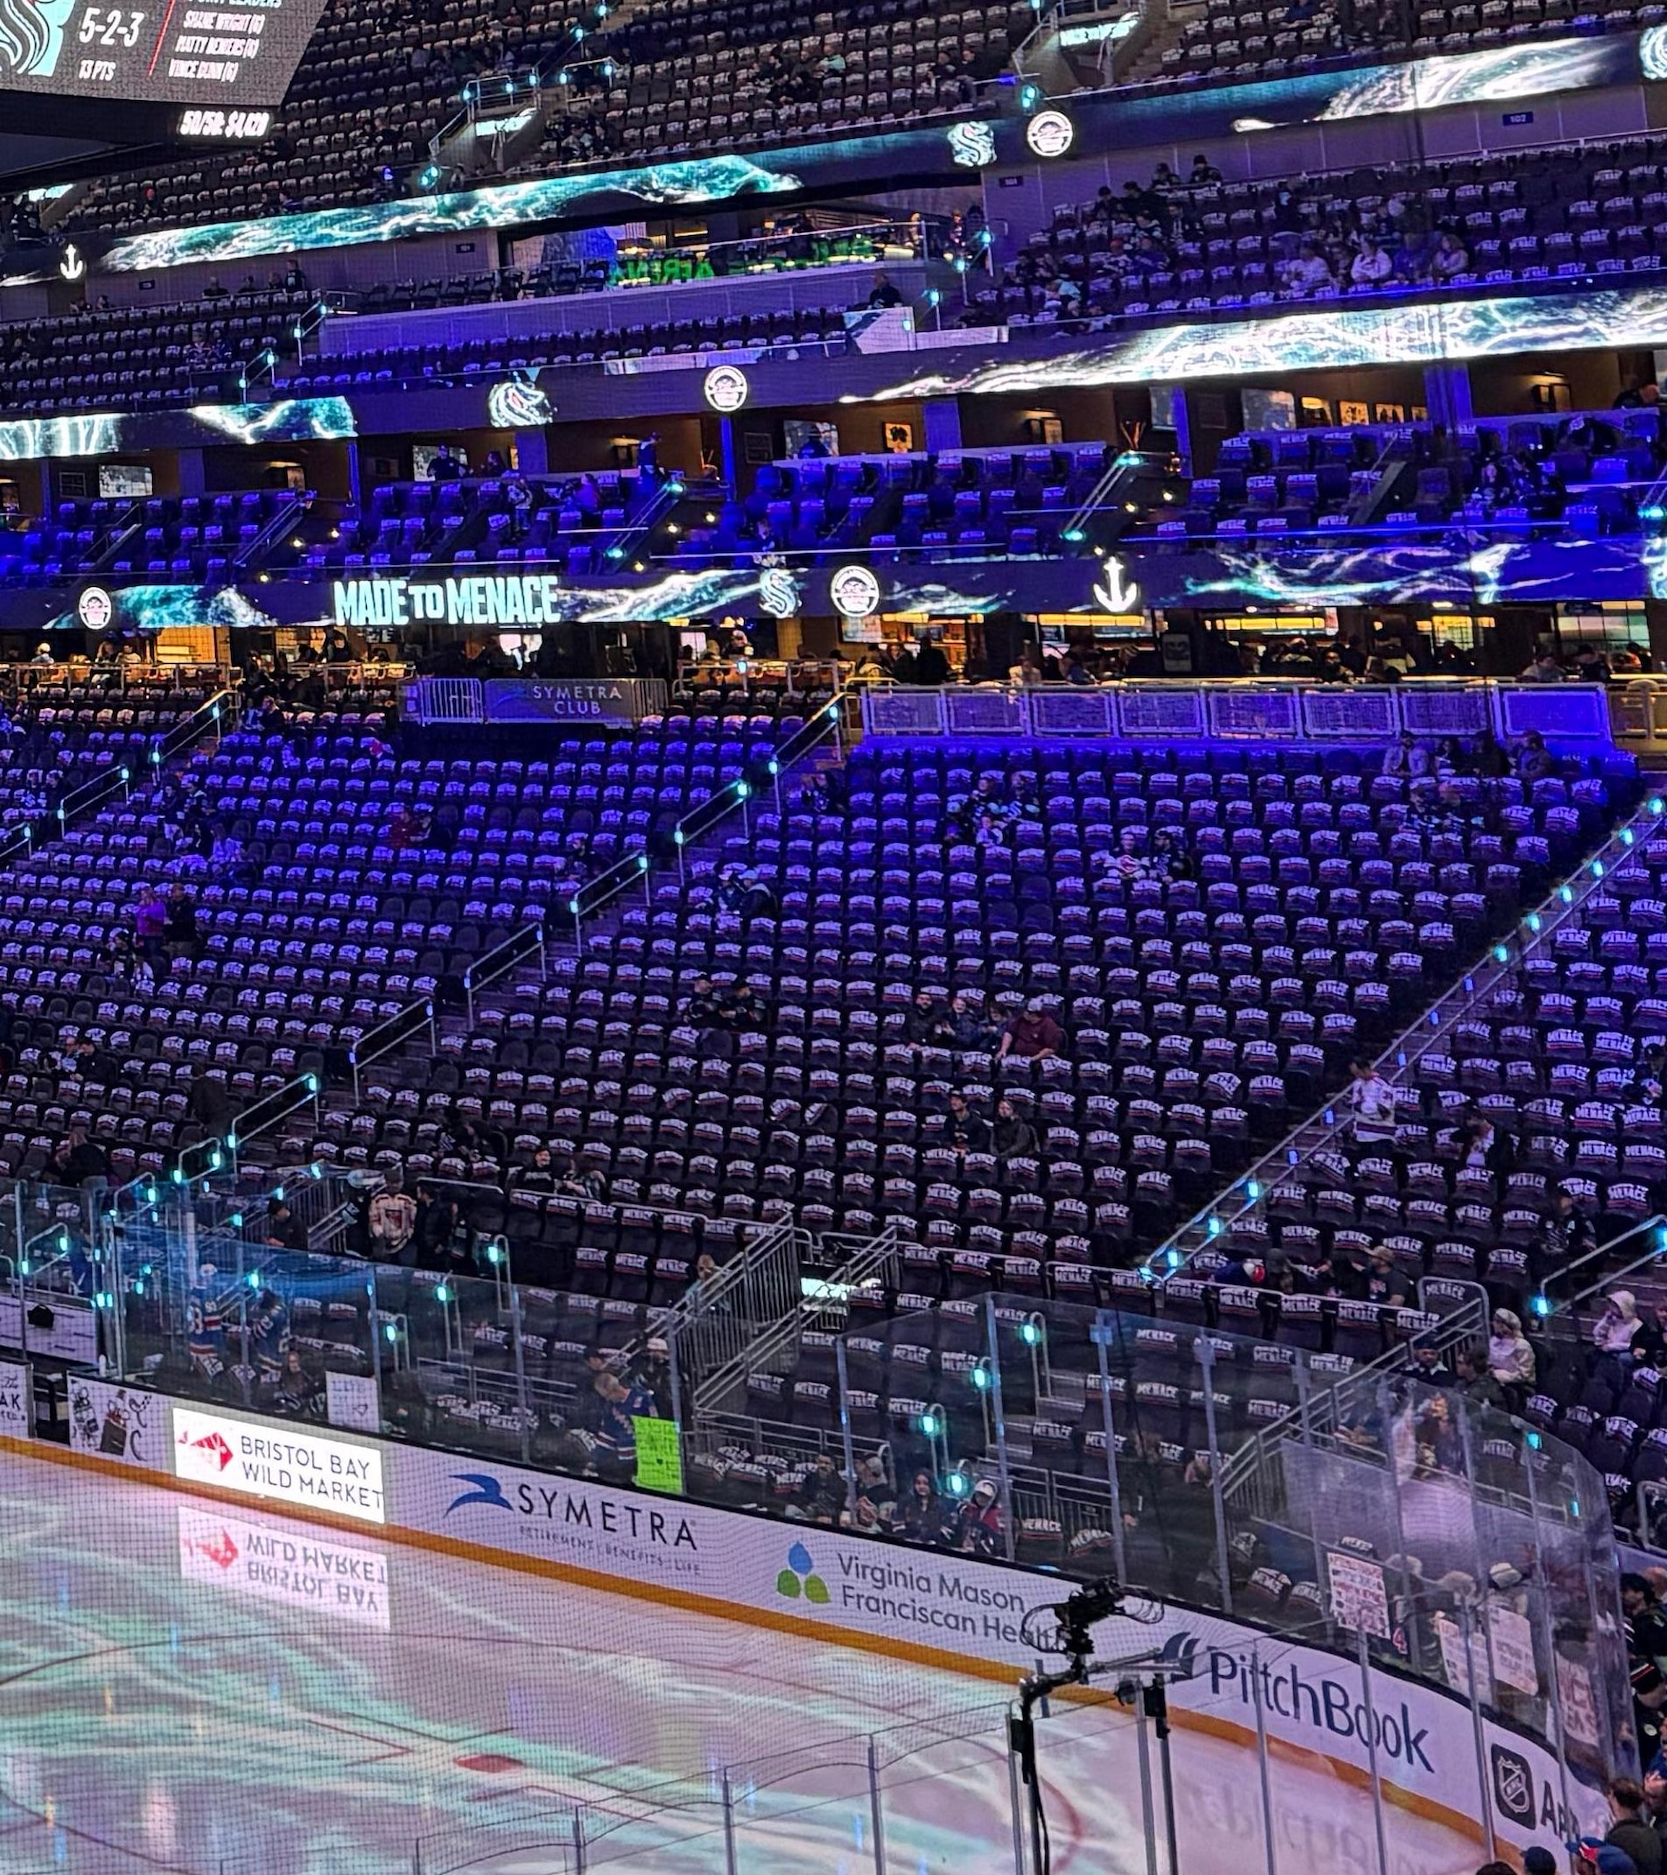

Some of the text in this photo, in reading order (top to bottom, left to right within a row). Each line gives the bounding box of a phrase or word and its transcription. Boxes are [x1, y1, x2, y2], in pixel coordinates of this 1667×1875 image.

[80, 6, 145, 47] 5-2-3
[93, 61, 116, 81] PTS
[334, 575, 562, 627] MADE TO MENACE
[532, 685, 624, 701] SYMETRA
[552, 701, 601, 715] CLUB
[240, 1435, 371, 1481] BRISTOL BAY
[242, 1461, 385, 1511] WILD MARKET
[518, 1481, 699, 1551] SYMETRA
[836, 1552, 1026, 1614] Virginia Mason
[841, 1582, 983, 1637] Franciscan
[1208, 1646, 1438, 1775] PitchBook
